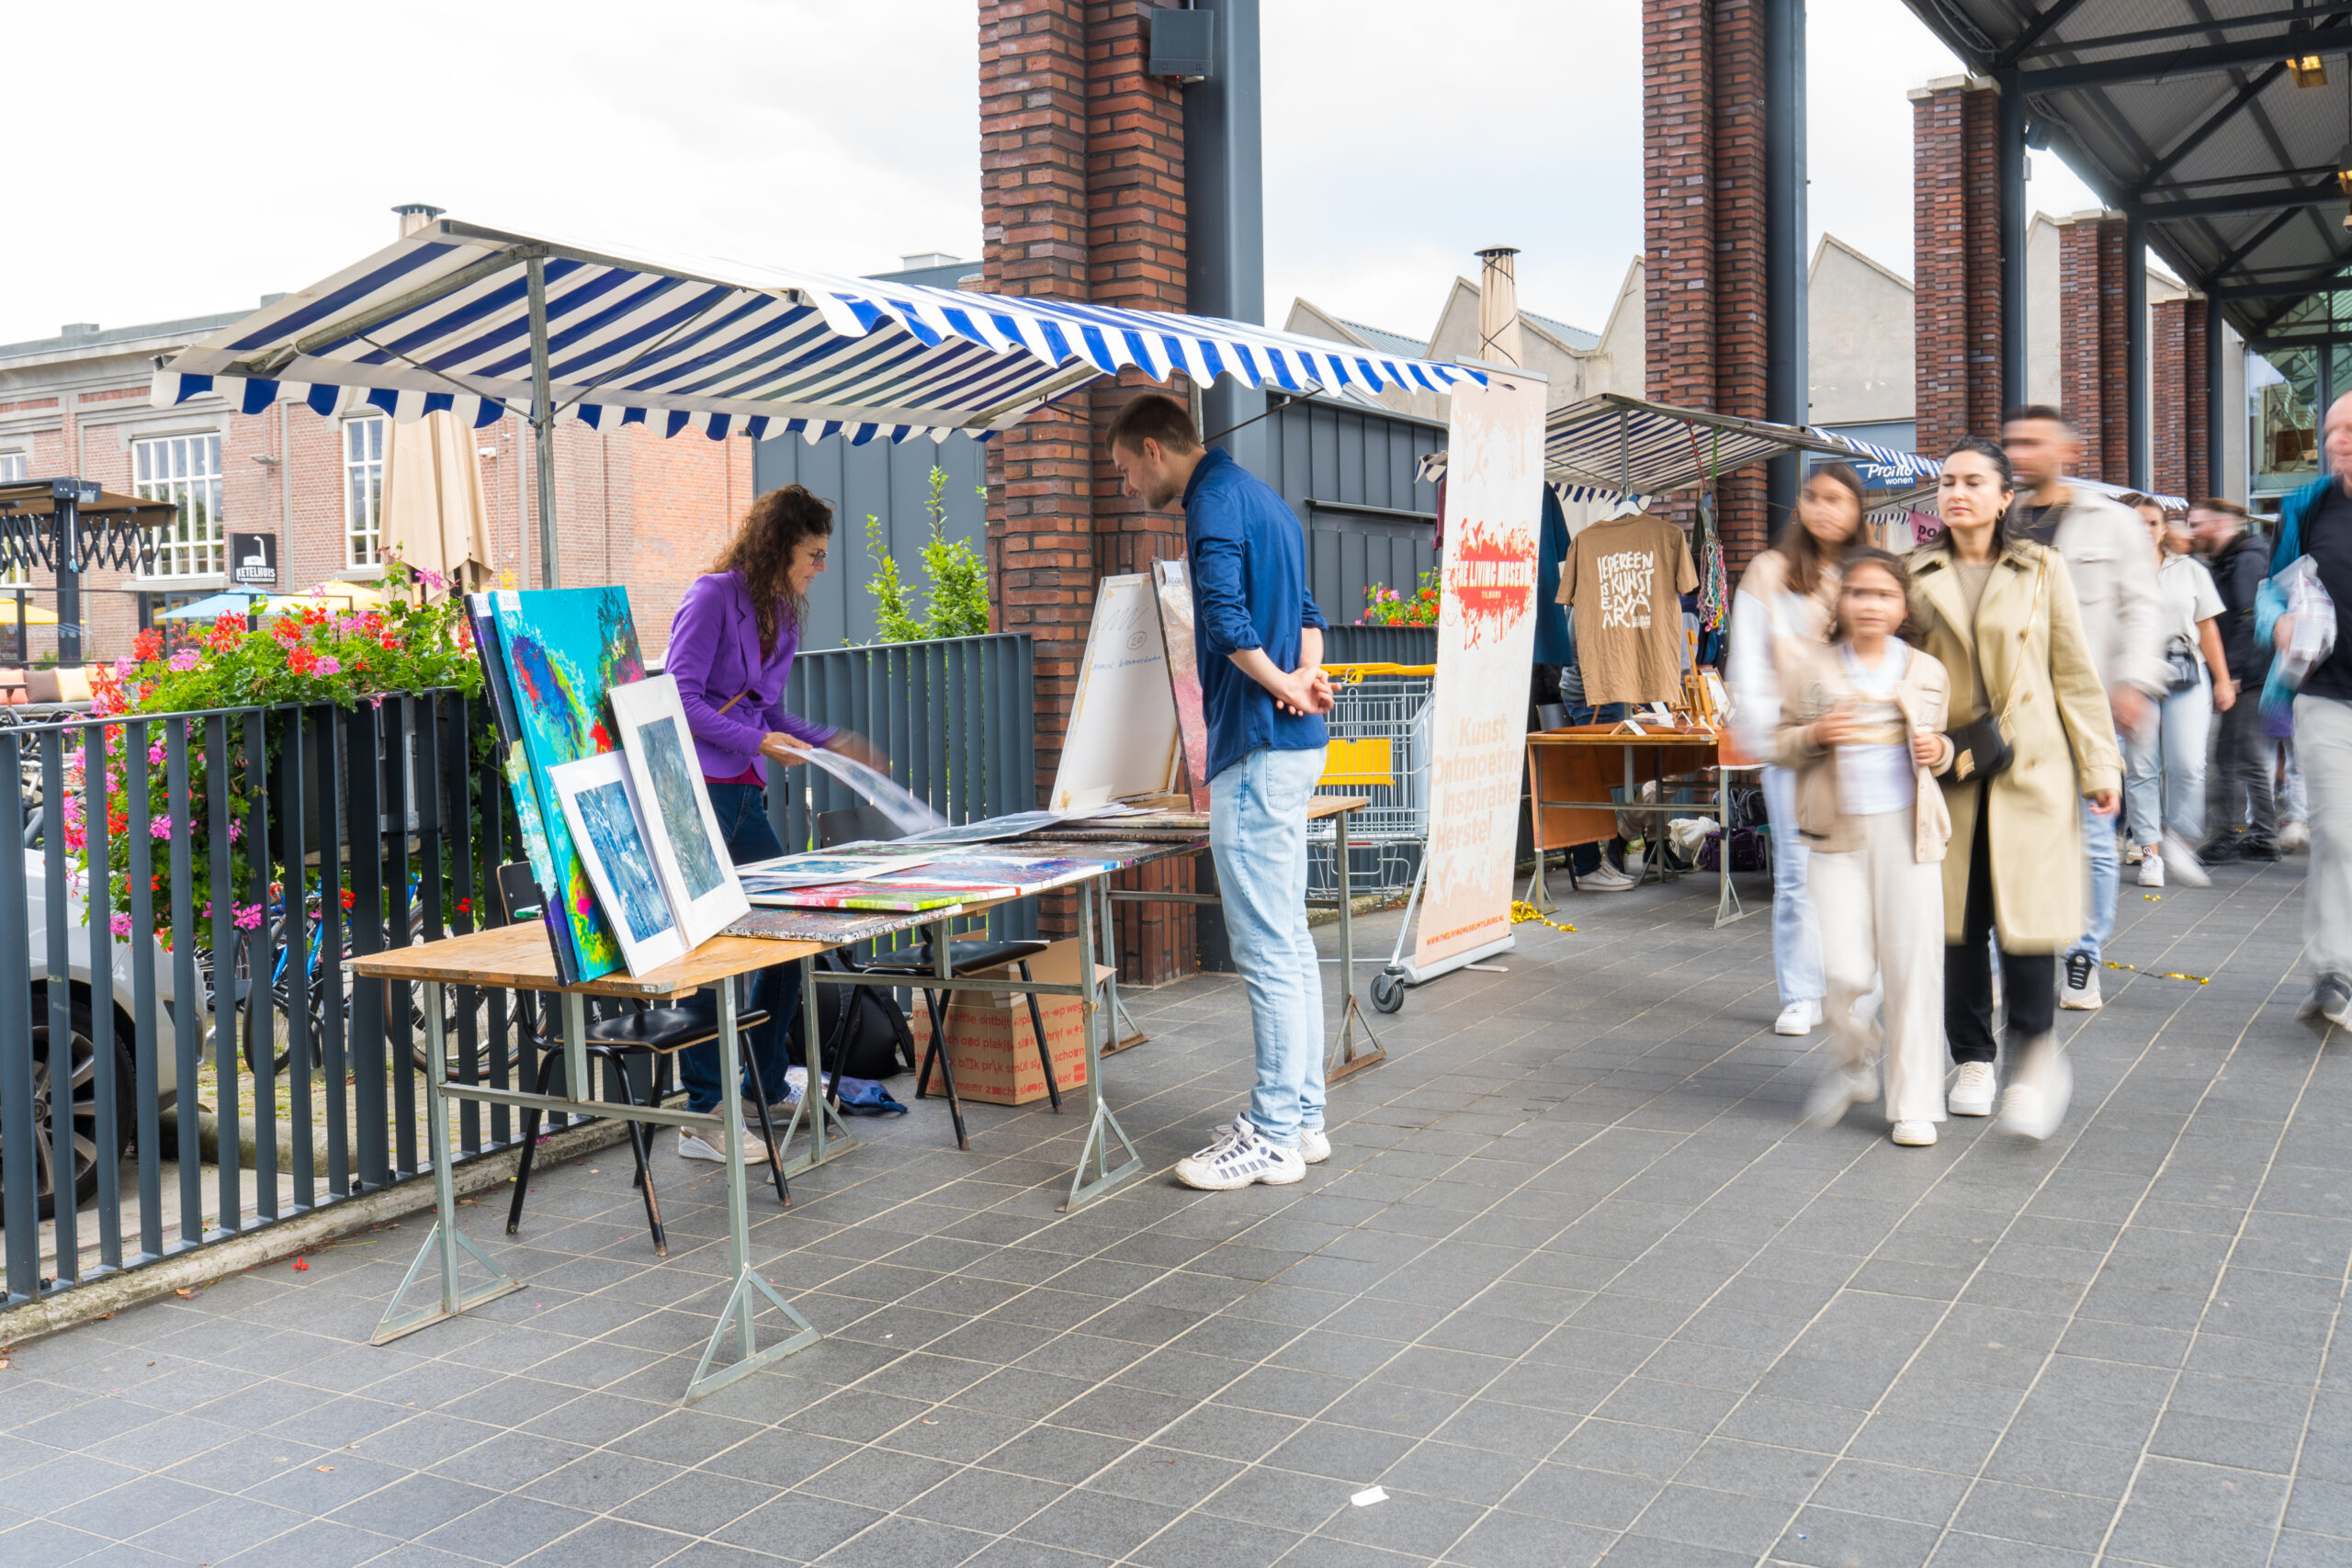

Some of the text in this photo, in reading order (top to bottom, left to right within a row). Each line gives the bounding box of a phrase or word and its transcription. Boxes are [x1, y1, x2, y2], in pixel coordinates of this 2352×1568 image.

[1884, 477, 1914, 485] wonen
[235, 566, 276, 581] KETELHUIS
[1469, 560, 1497, 587] LIVING
[1497, 560, 1532, 587] MUSEUM
[1458, 712, 1508, 748] Kunst
[1435, 810, 1493, 855] Herstel
[948, 1011, 977, 1024] koffie
